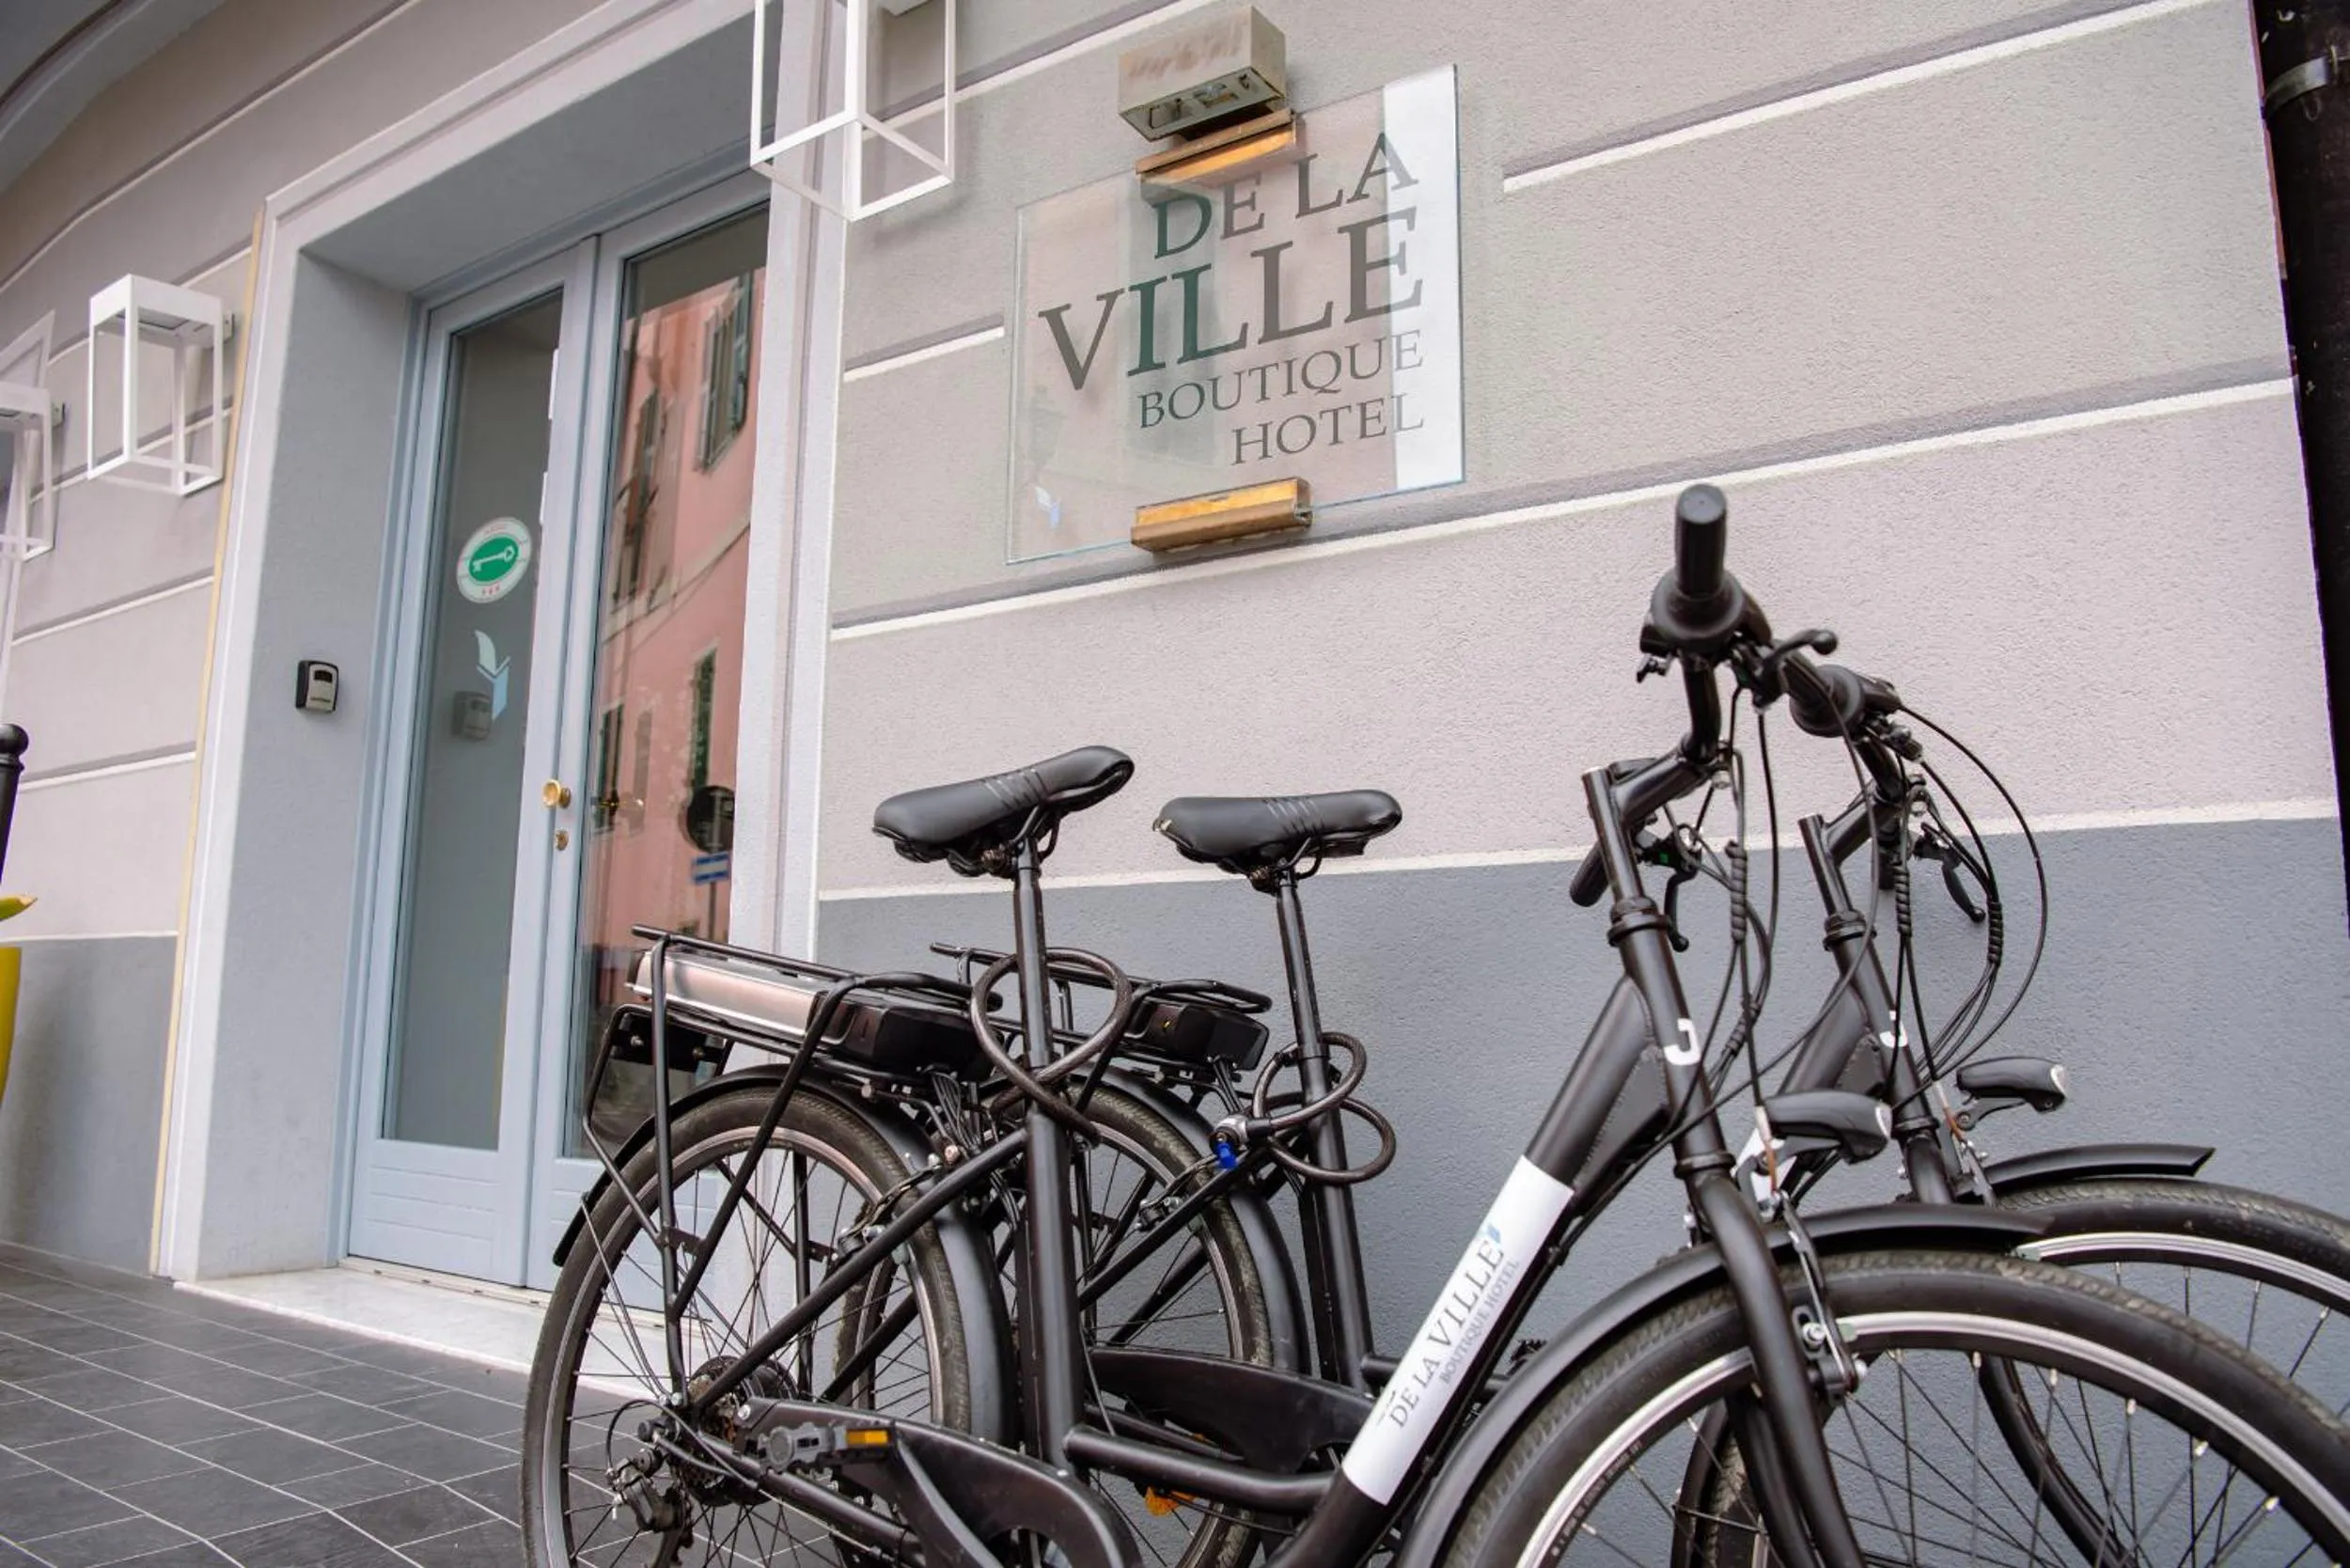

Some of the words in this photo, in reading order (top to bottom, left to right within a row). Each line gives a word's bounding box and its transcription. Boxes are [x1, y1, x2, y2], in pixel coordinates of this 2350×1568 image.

[1154, 172, 1265, 259] DE
[1295, 132, 1419, 218] LA
[1038, 207, 1423, 391] VILLE
[1137, 329, 1424, 429] BOUTIQUE
[1231, 394, 1424, 465] HOTEL
[1389, 1388, 1419, 1428] DE
[1413, 1356, 1441, 1388] LA
[1427, 1239, 1504, 1347] VILLE
[1439, 1307, 1490, 1386] BOUTIQUE
[1486, 1259, 1521, 1310] HOTEL
